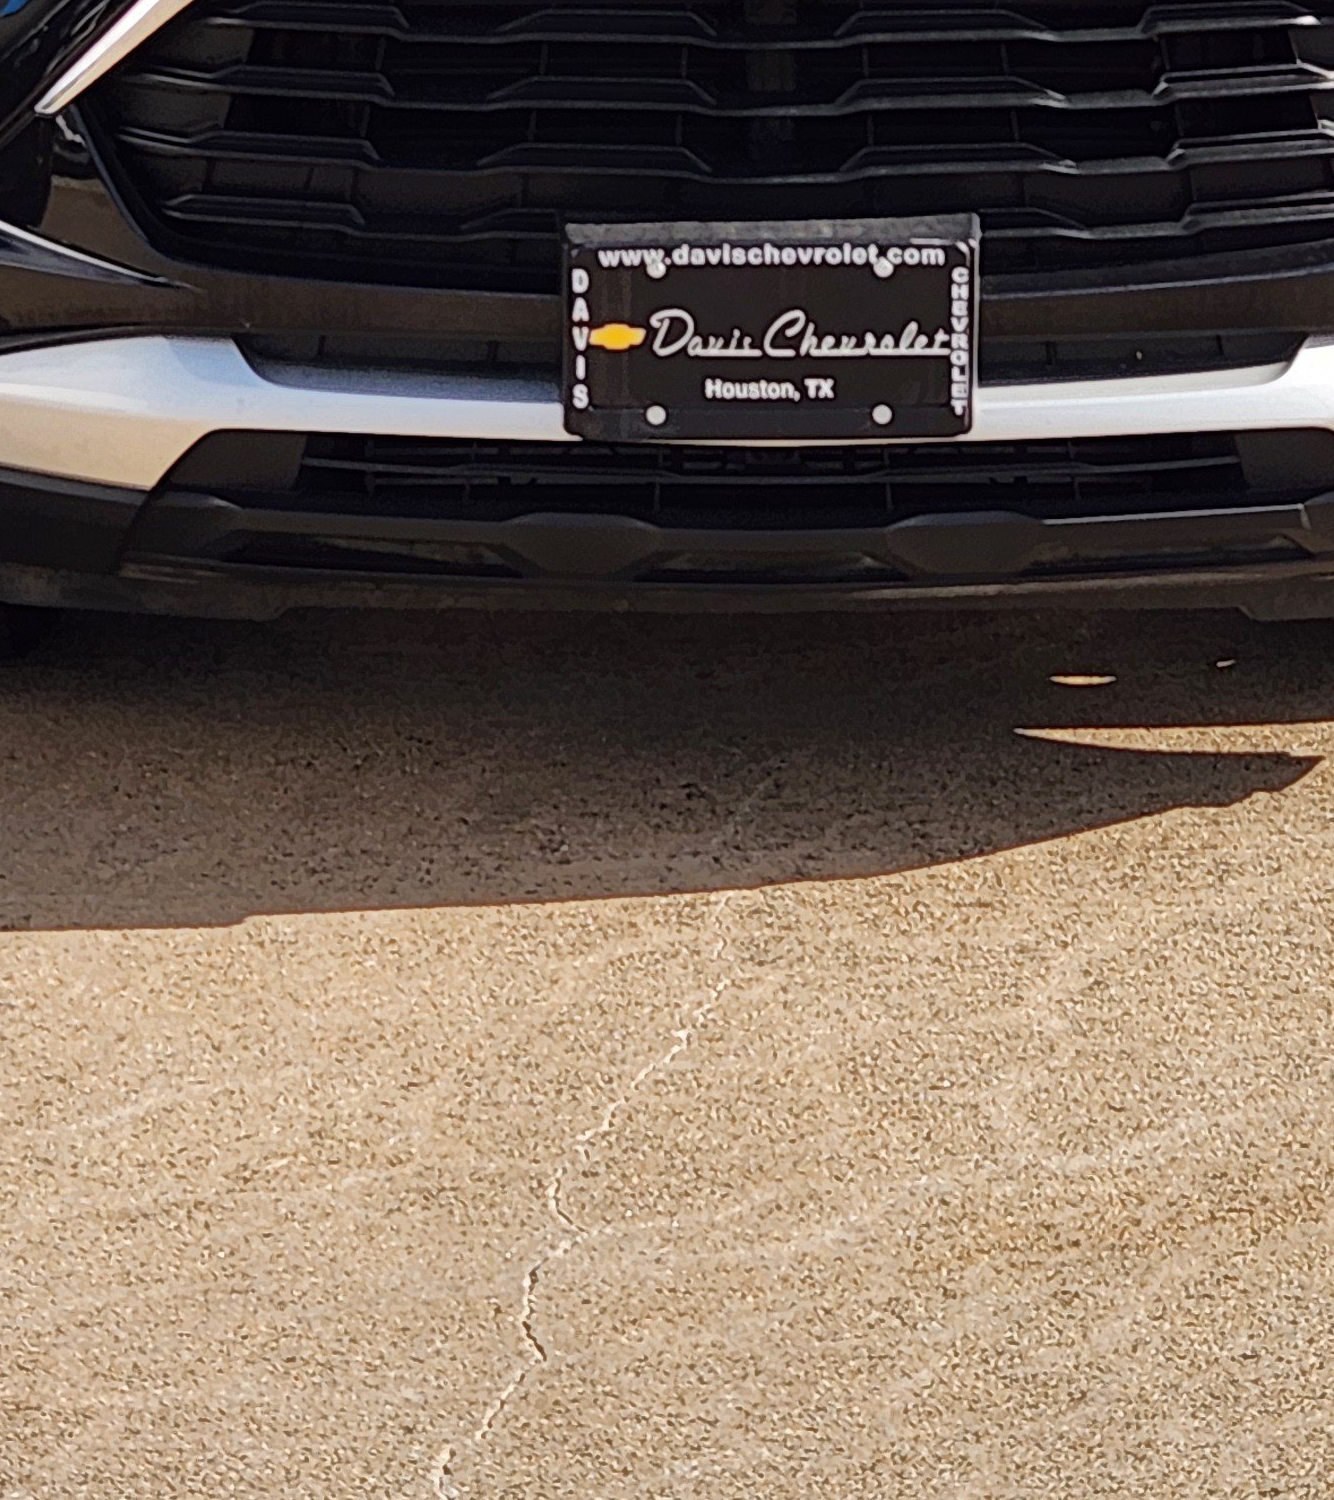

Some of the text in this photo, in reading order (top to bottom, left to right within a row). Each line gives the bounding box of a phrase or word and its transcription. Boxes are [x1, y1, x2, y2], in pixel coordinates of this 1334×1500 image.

[571, 268, 590, 409] DAVIS
[649, 308, 951, 357] Davis Chevrolet
[950, 266, 969, 416] CHEVROLET
[704, 377, 835, 402] Houston, TX
